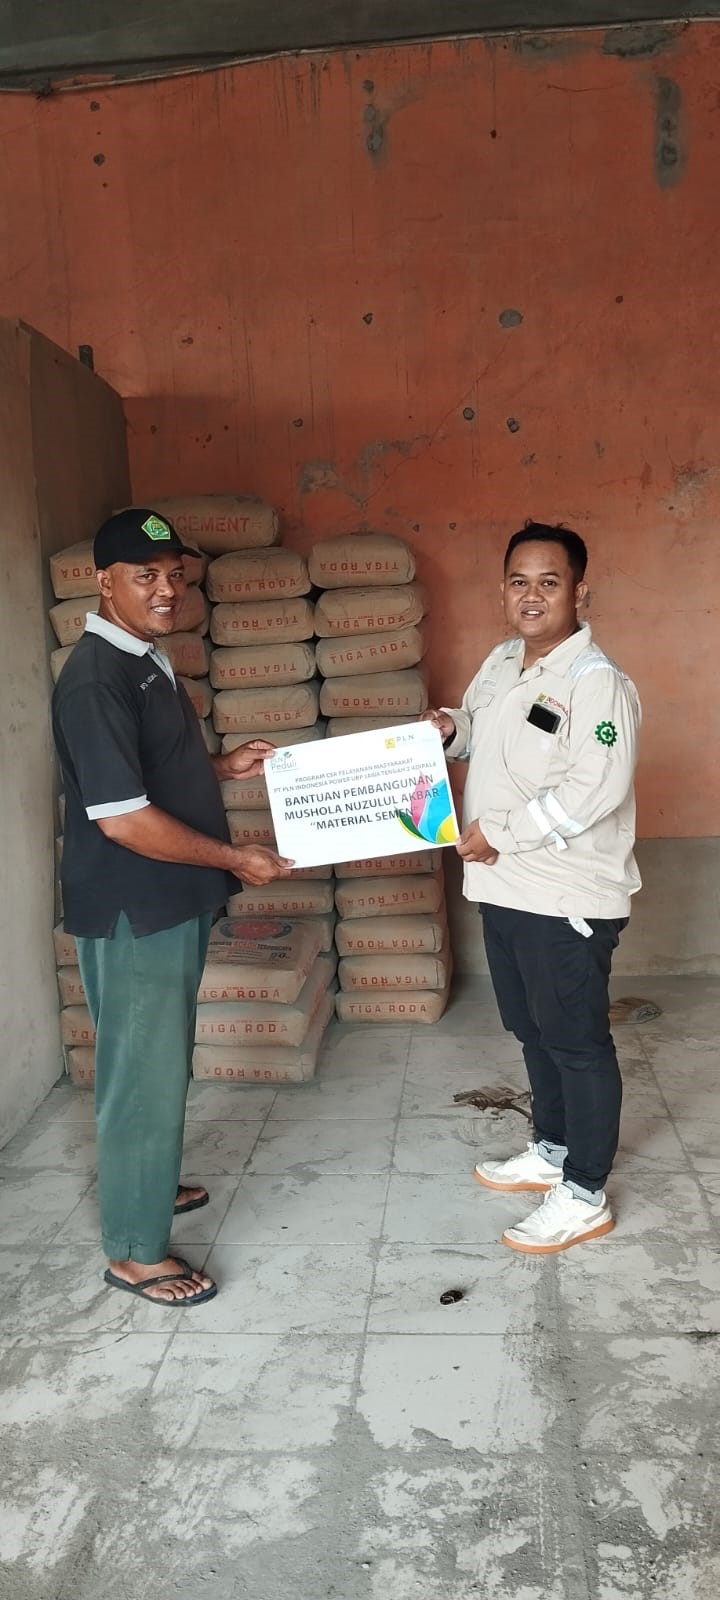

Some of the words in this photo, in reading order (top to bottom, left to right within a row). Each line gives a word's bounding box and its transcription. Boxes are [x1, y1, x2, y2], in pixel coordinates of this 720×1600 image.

[320, 562, 357, 571] RODA
[365, 561, 399, 570] TIGA
[61, 566, 92, 577] ODA
[219, 583, 251, 593] TIGA
[222, 619, 259, 629] RODA
[267, 615, 298, 626] TIGA
[328, 620, 360, 629] TIGA
[368, 615, 405, 627] RODA
[330, 651, 363, 664] TIGA
[369, 640, 408, 656] RODA
[219, 666, 256, 677] RODA
[264, 663, 296, 673] TIGA
[332, 697, 370, 707] RODA
[396, 733, 415, 743] PLN
[271, 760, 297, 771] Peduli
[295, 774, 326, 783] PROGRAM
[338, 765, 373, 776] PELAYANAN
[374, 758, 413, 770] MASYARAKAT
[295, 781, 329, 790] INDONESIA
[329, 777, 351, 785] POWER
[381, 766, 406, 777] TENGAH
[411, 762, 437, 771] ADIPALA
[231, 790, 264, 800] TIGA
[285, 789, 341, 807] BANTUAN
[343, 774, 434, 798] PEMBANGUNAN
[284, 803, 342, 821] MUSHOLA
[345, 795, 399, 812] NUZULUL
[401, 787, 440, 802] AKBAR
[390, 858, 423, 867] TIGA
[392, 890, 425, 902] TIGA
[347, 939, 384, 949] RODA
[392, 939, 425, 948] TIGA
[351, 976, 388, 985] RODA
[395, 975, 428, 984] TIGA
[202, 990, 229, 999] IGA
[237, 989, 280, 999] RODA
[349, 1005, 382, 1013] TIGA
[388, 1004, 428, 1013] RODA
[201, 1023, 236, 1034] TIGA
[245, 1023, 288, 1033] RODA
[204, 1066, 245, 1077] RODA
[254, 1070, 289, 1080] TIGA
